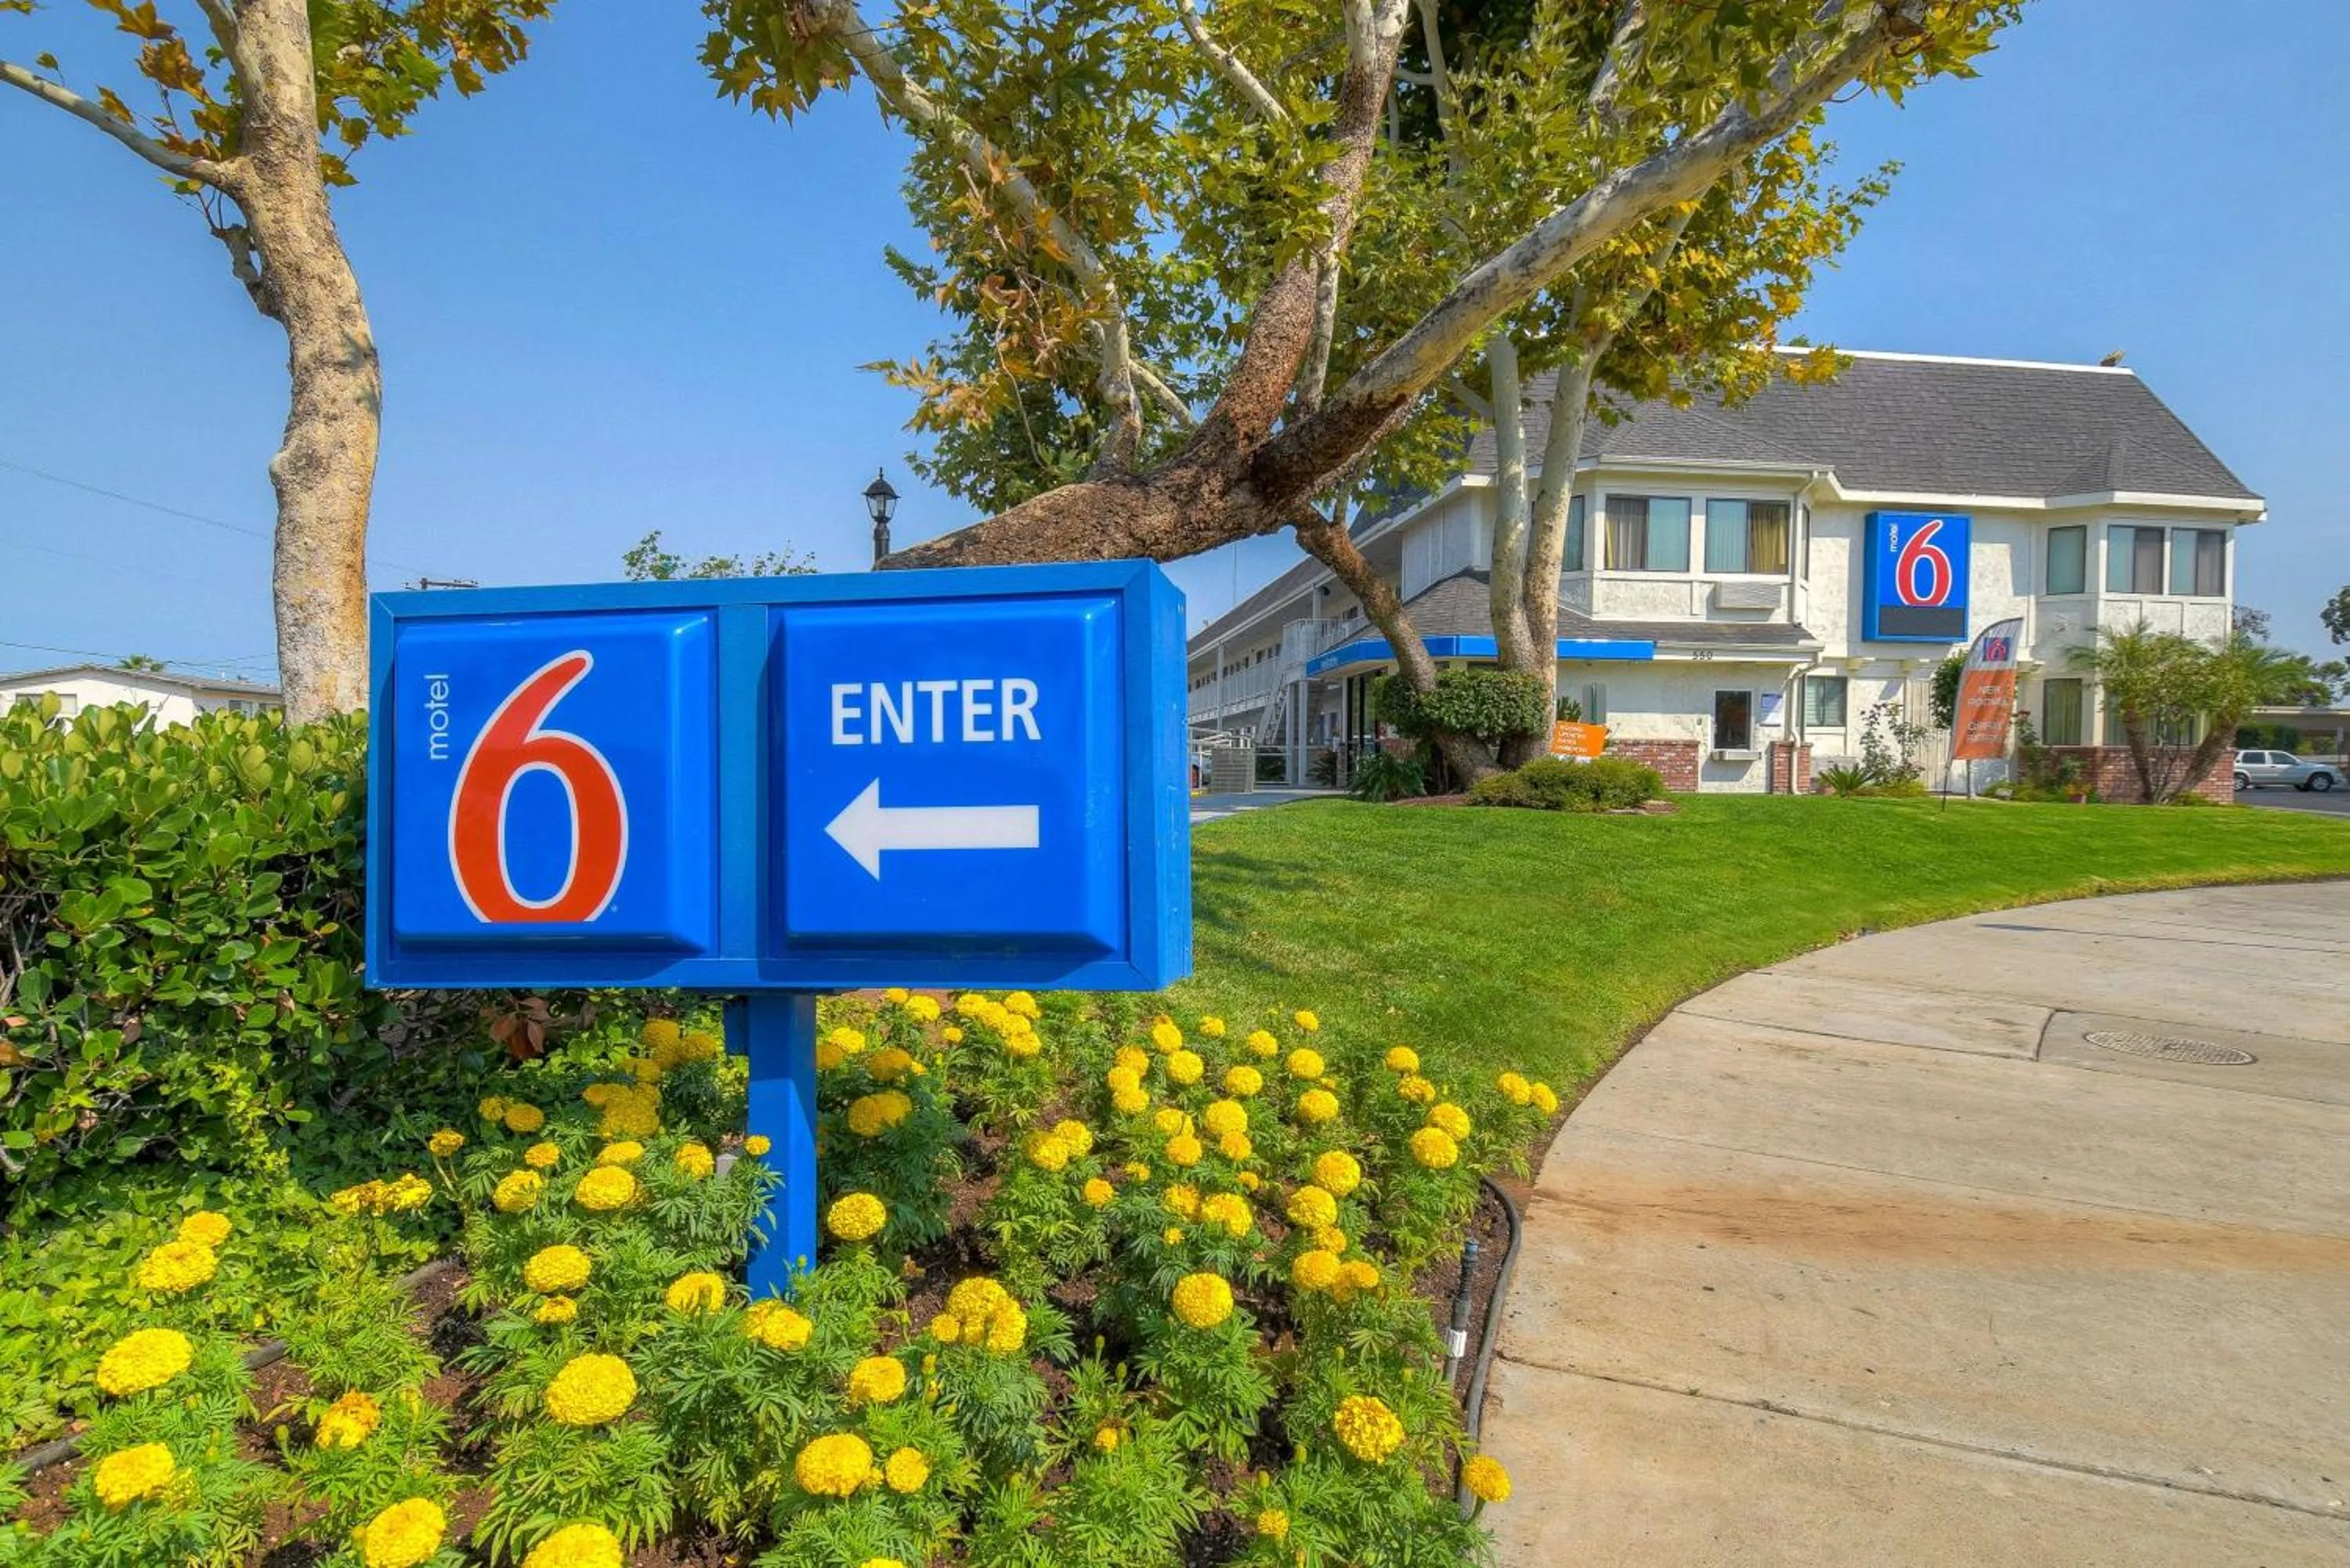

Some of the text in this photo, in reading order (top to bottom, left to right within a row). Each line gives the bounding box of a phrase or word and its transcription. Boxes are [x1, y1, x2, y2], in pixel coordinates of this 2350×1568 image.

[1889, 519, 1952, 606] motel 6
[831, 677, 1042, 745] ENTER
[424, 649, 628, 923] motel 6
